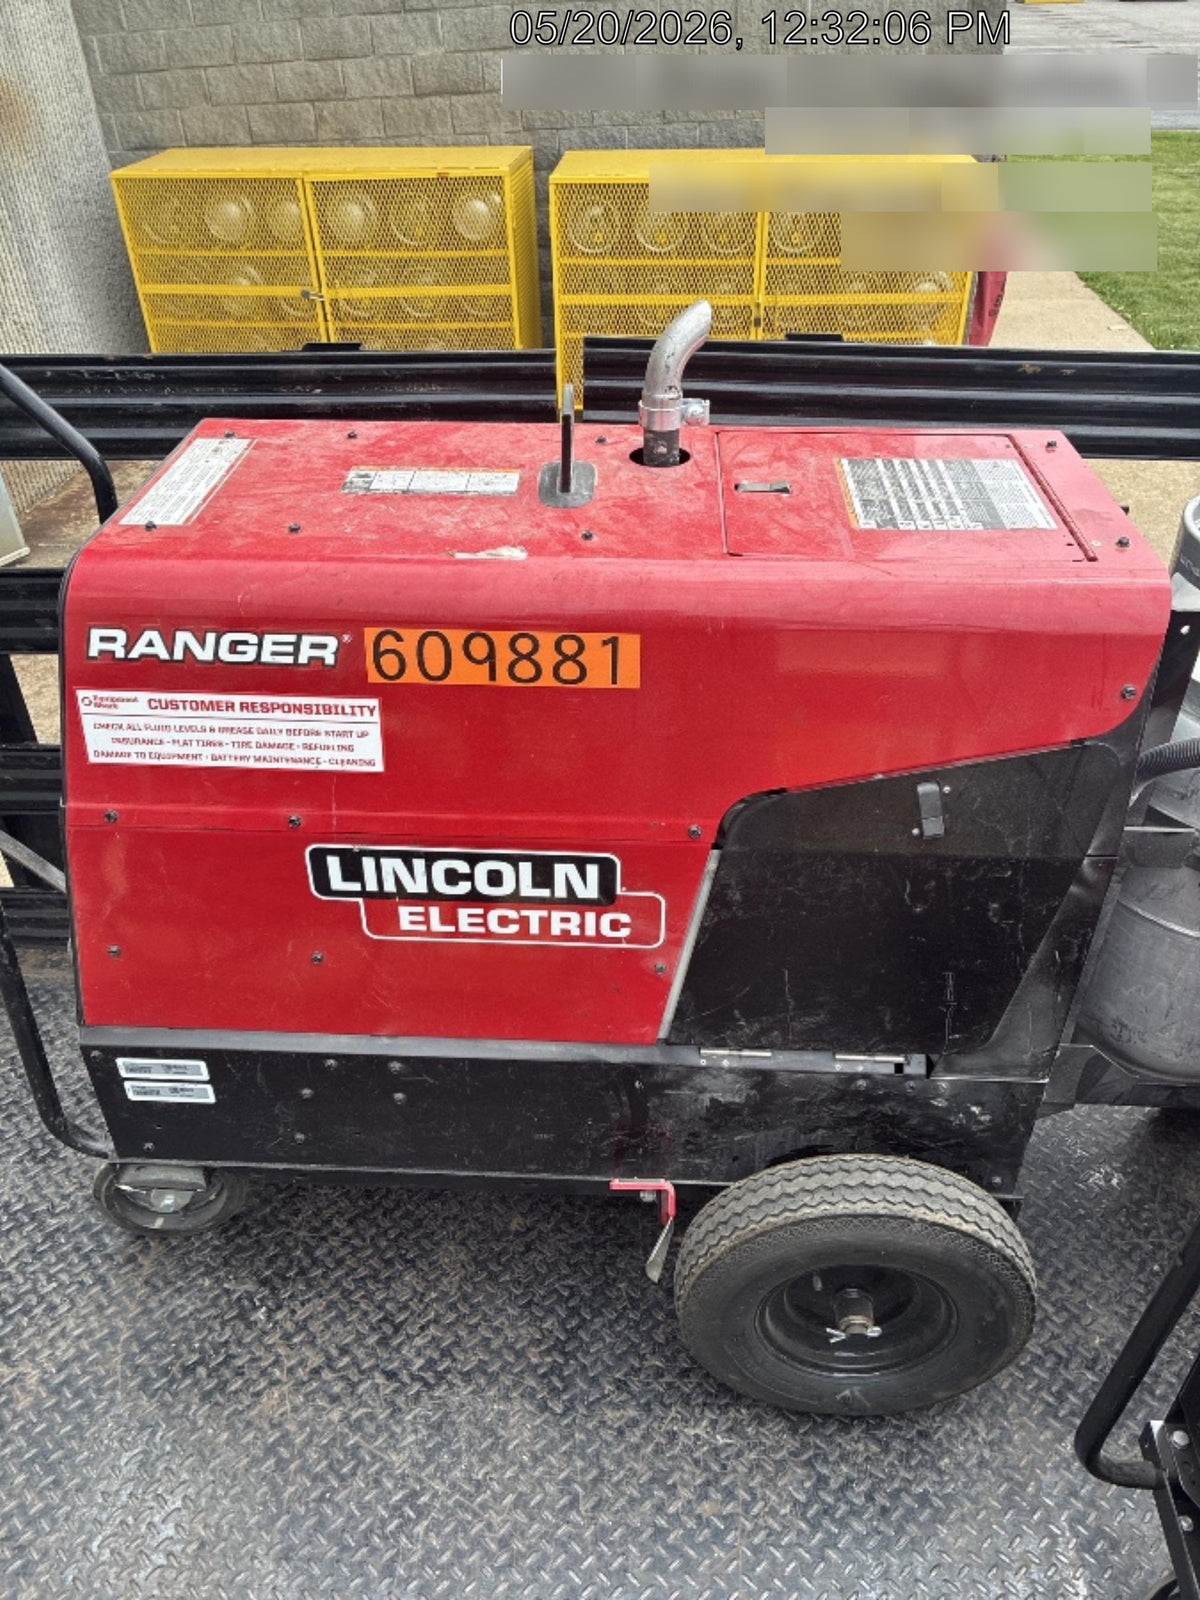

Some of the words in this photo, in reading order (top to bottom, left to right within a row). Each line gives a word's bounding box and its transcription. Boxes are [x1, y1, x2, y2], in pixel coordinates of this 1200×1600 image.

[372, 628, 620, 685] 609881
[147, 698, 235, 712] CUSTOMER
[239, 701, 376, 717] RESPONSIBILITY
[174, 725, 206, 733] LEVELS
[356, 731, 369, 739] UP
[326, 855, 600, 899] LINCOLN
[397, 905, 632, 937] ELECTRIC
